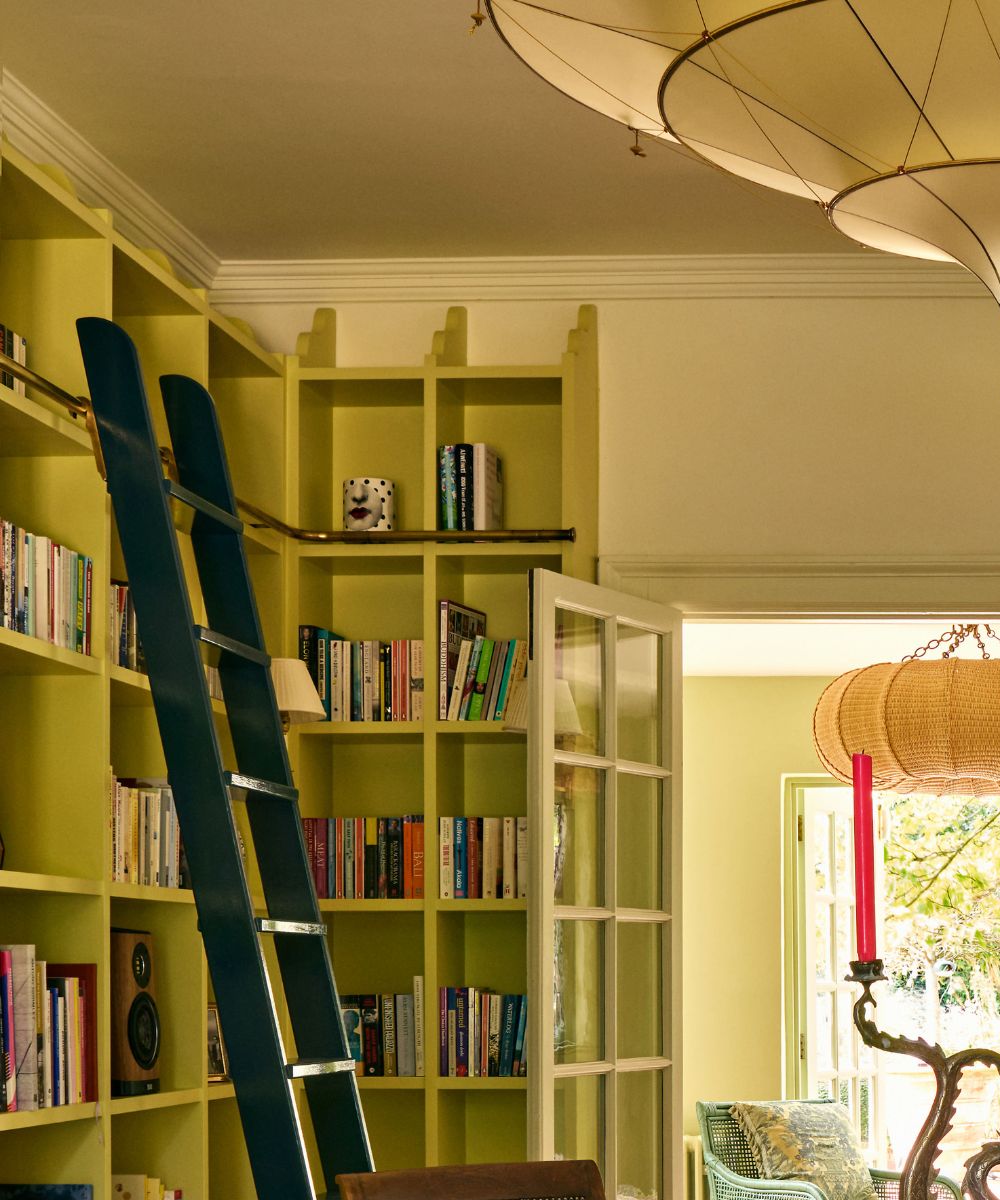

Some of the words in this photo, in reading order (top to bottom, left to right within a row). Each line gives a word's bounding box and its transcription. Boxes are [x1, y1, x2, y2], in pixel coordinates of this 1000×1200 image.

[440, 641, 448, 683] BUDDHISM
[316, 842, 325, 867] MEAT
[413, 851, 424, 878] BALI
